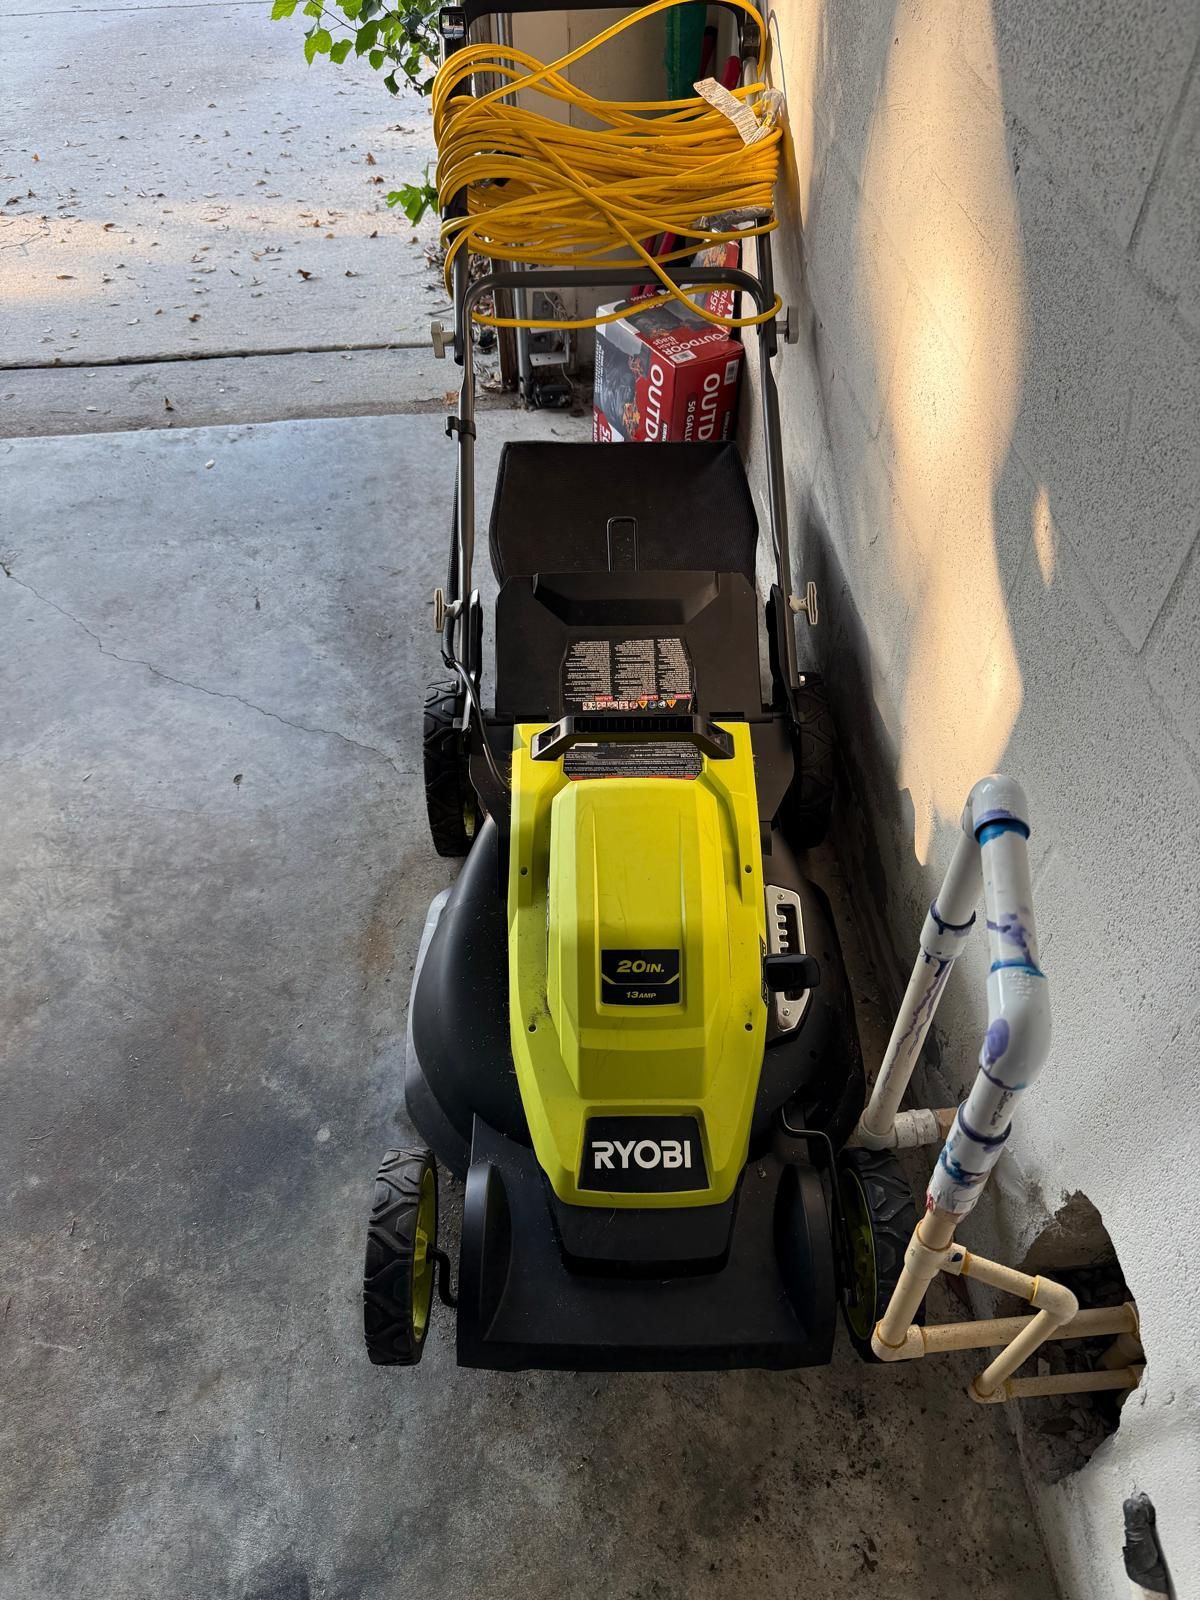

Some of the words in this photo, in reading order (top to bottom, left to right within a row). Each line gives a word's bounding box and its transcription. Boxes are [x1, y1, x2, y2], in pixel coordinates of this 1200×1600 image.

[709, 290, 719, 311] ags
[716, 289, 729, 317] RASH
[662, 333, 724, 356] OUTDOOR
[646, 364, 664, 442] OUTD
[687, 400, 696, 413] 50
[698, 373, 721, 441] OUTD
[591, 1139, 692, 1169] RYOBI
